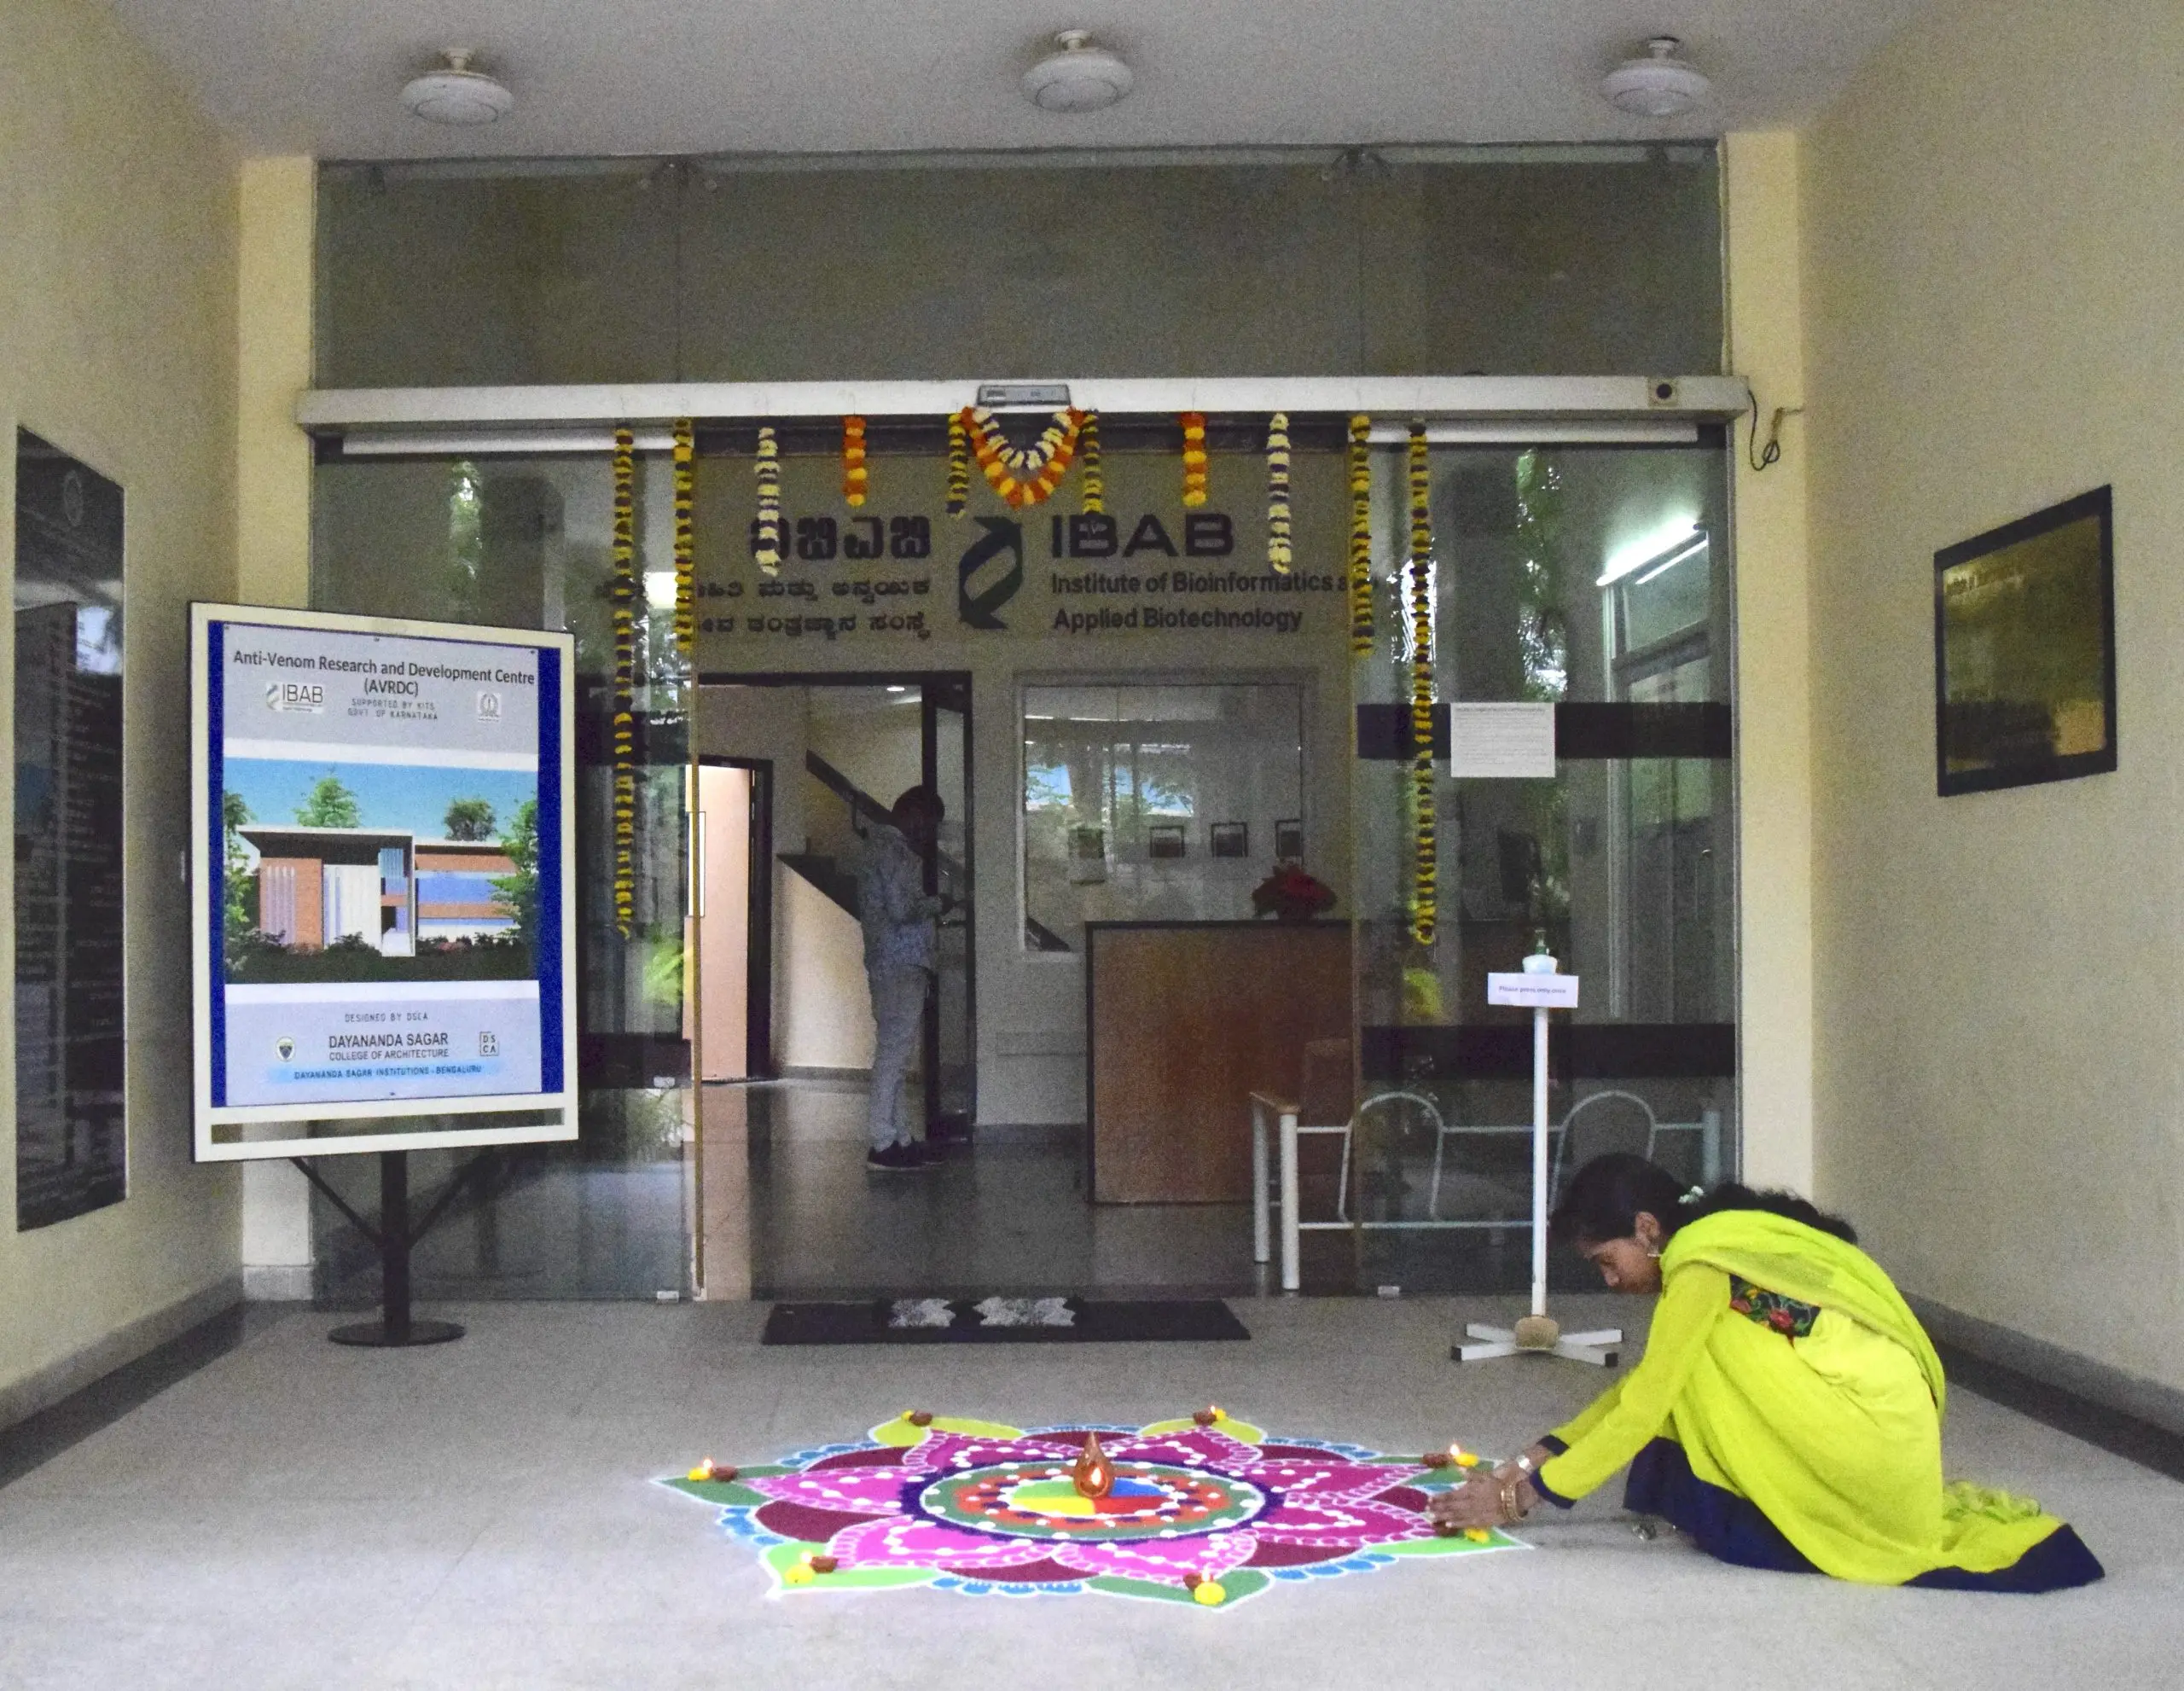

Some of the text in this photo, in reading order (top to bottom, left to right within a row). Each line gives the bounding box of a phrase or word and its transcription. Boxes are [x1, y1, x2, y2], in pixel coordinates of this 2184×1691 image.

[1052, 514, 1234, 558] IBAB
[1052, 572, 1141, 594] Institute
[1146, 572, 1168, 594] of
[1172, 571, 1333, 592] Bioinformatics
[1054, 606, 1303, 635] Applied Biotechnology
[233, 650, 535, 685] Anti-Venom Research and Development Centre
[282, 683, 324, 704] IBAB
[363, 678, 420, 697] (AVRDC)
[351, 698, 398, 709] SUPPORTED
[402, 700, 413, 709] BY
[390, 710, 439, 720] KARNATAKA
[345, 1013, 386, 1023] DESIGNED
[390, 1013, 402, 1021] BY
[328, 1032, 449, 1049] DAYANANDA SAGAR
[329, 1049, 450, 1061] COLLEGE OF ARCHITECTURE
[293, 1071, 343, 1080] DAYANANDA
[376, 1066, 429, 1077] INSTITUTIONS
[436, 1065, 482, 1075] BENGALURU
